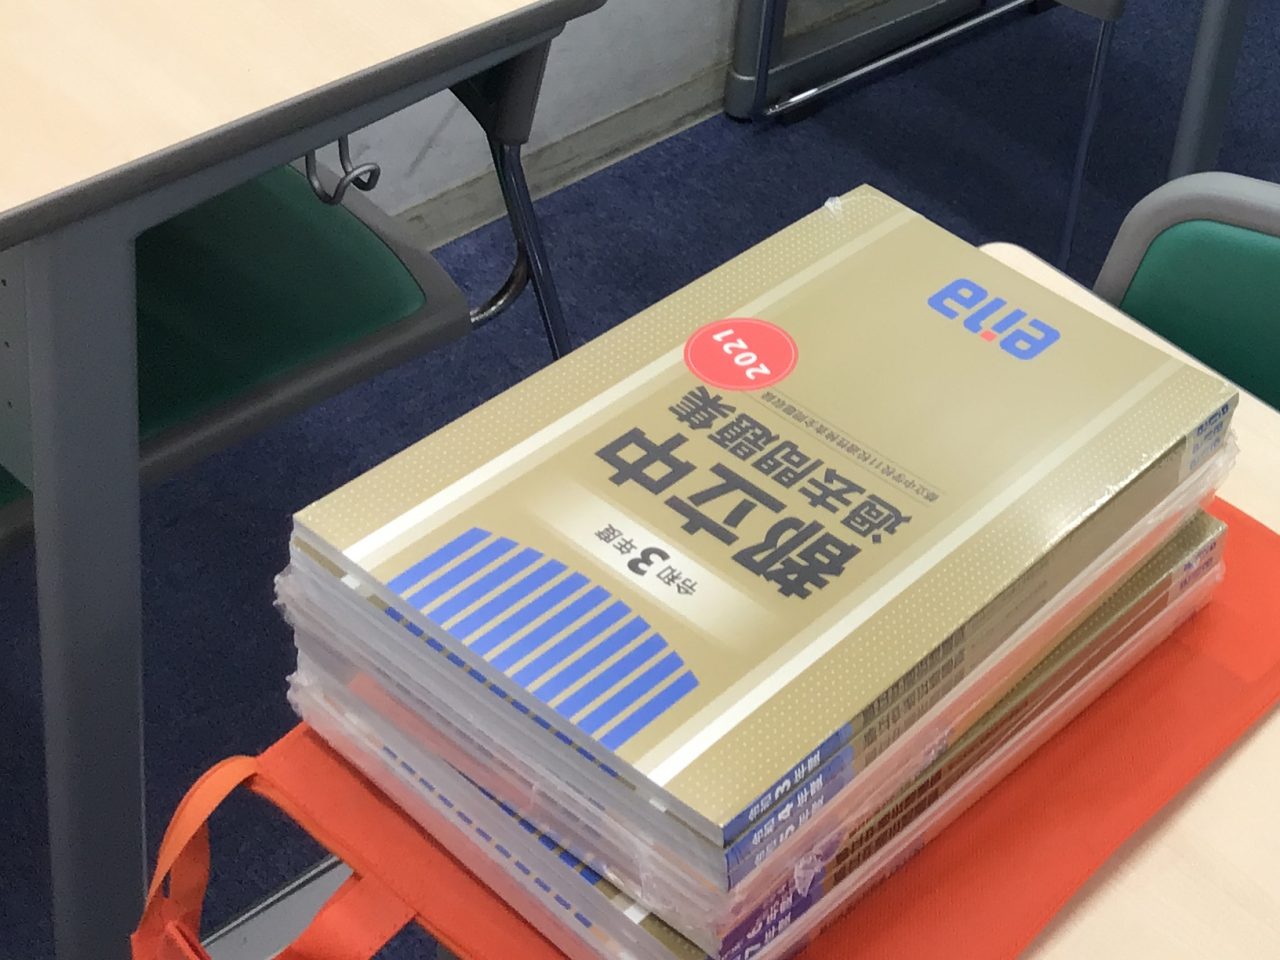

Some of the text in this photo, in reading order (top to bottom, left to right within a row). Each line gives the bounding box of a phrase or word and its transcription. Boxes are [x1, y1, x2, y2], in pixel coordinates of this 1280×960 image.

[713, 329, 771, 380] 2021
[928, 278, 1061, 361] ena
[668, 386, 912, 544] 過去問題集
[595, 427, 861, 599] 都立中
[594, 524, 698, 597] 令和3年度
[748, 751, 821, 821] 令和3年度
[752, 774, 823, 845] 令和4年度
